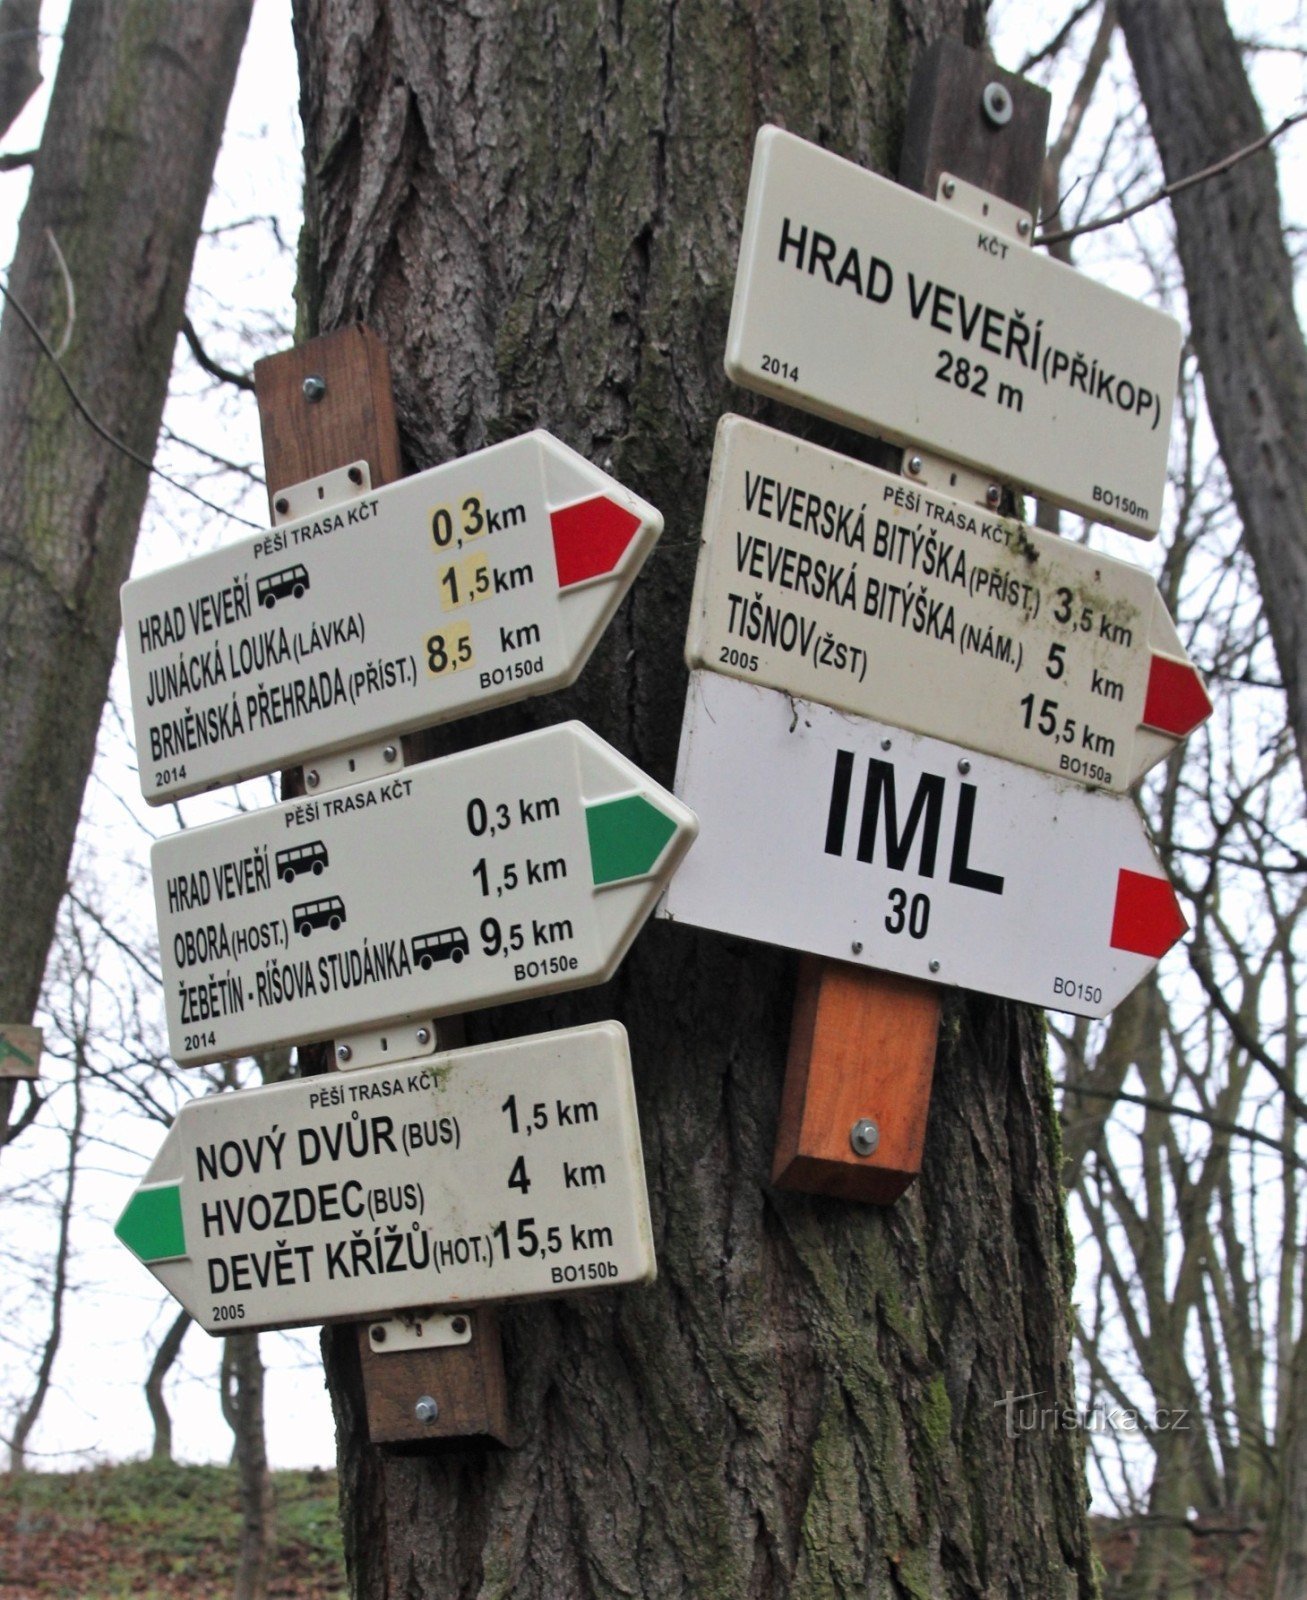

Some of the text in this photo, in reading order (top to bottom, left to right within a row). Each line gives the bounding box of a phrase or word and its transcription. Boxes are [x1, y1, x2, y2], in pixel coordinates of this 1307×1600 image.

[978, 233, 1009, 260] KČT
[777, 217, 1161, 430] HRAD VEVEŘÍ (PŘÍKOP)
[761, 353, 800, 382] 2014
[935, 349, 1024, 412] 282 m
[254, 501, 379, 559] PĚŠÍ TRASA KČT
[883, 485, 1011, 545] PĚŠÍ TRASA KČT
[1092, 485, 1149, 520] BO150m
[139, 497, 527, 653] HRAD VEVEŘÍ 0,3 km
[744, 470, 865, 552] VEVERSKÁ
[873, 518, 967, 588] BITÝŠKA
[1054, 587, 1092, 634] 3,5
[1099, 613, 1132, 648] km
[146, 563, 534, 706] JUNÁCKÁ LOUKA (LÁVKA) 1,5 km
[735, 531, 1124, 701] VEVERSKÁ BITÝŠKA (NÁM.) 5 km
[479, 656, 544, 689] BO150d
[719, 646, 759, 672] 2005
[728, 591, 1116, 757] TIŠNOV (ŽST) 15,5 km
[150, 623, 541, 761] BRNĚNSKÁ PŘEHRADA (PŘÍST.) 8,5 km
[155, 765, 187, 787] 2014
[1059, 753, 1112, 783] BO150a
[285, 779, 413, 828] PĚŠÍ TRASA KČT
[825, 749, 1004, 894] IML
[167, 797, 560, 912] HRAD VEVEŘÍ 0,3 km
[174, 858, 567, 968] OBORA (HOST.) 1,5 km
[885, 887, 931, 940] 30
[179, 969, 244, 1023] ŽEBĚTÍN
[257, 958, 315, 1005] RÍŠOVA
[320, 937, 412, 993] STUDÁNKA
[480, 917, 523, 958] 9,5
[533, 917, 574, 945] km
[514, 956, 578, 981] BO150e
[1053, 977, 1102, 1004] BO150
[184, 1031, 216, 1052] 2014
[310, 1071, 441, 1109] PĚŠÍ TRASA KČT
[196, 1095, 598, 1182] NOVÝ DVŮR (BUS) 1,5 km
[202, 1156, 605, 1237] HVOZDEC (BUS) 4 km
[208, 1218, 613, 1294] DEVĚT KŘÍŽŮ (HOT.) 15,5 km
[551, 1262, 618, 1283] BO150b
[213, 1305, 245, 1322] 2005
